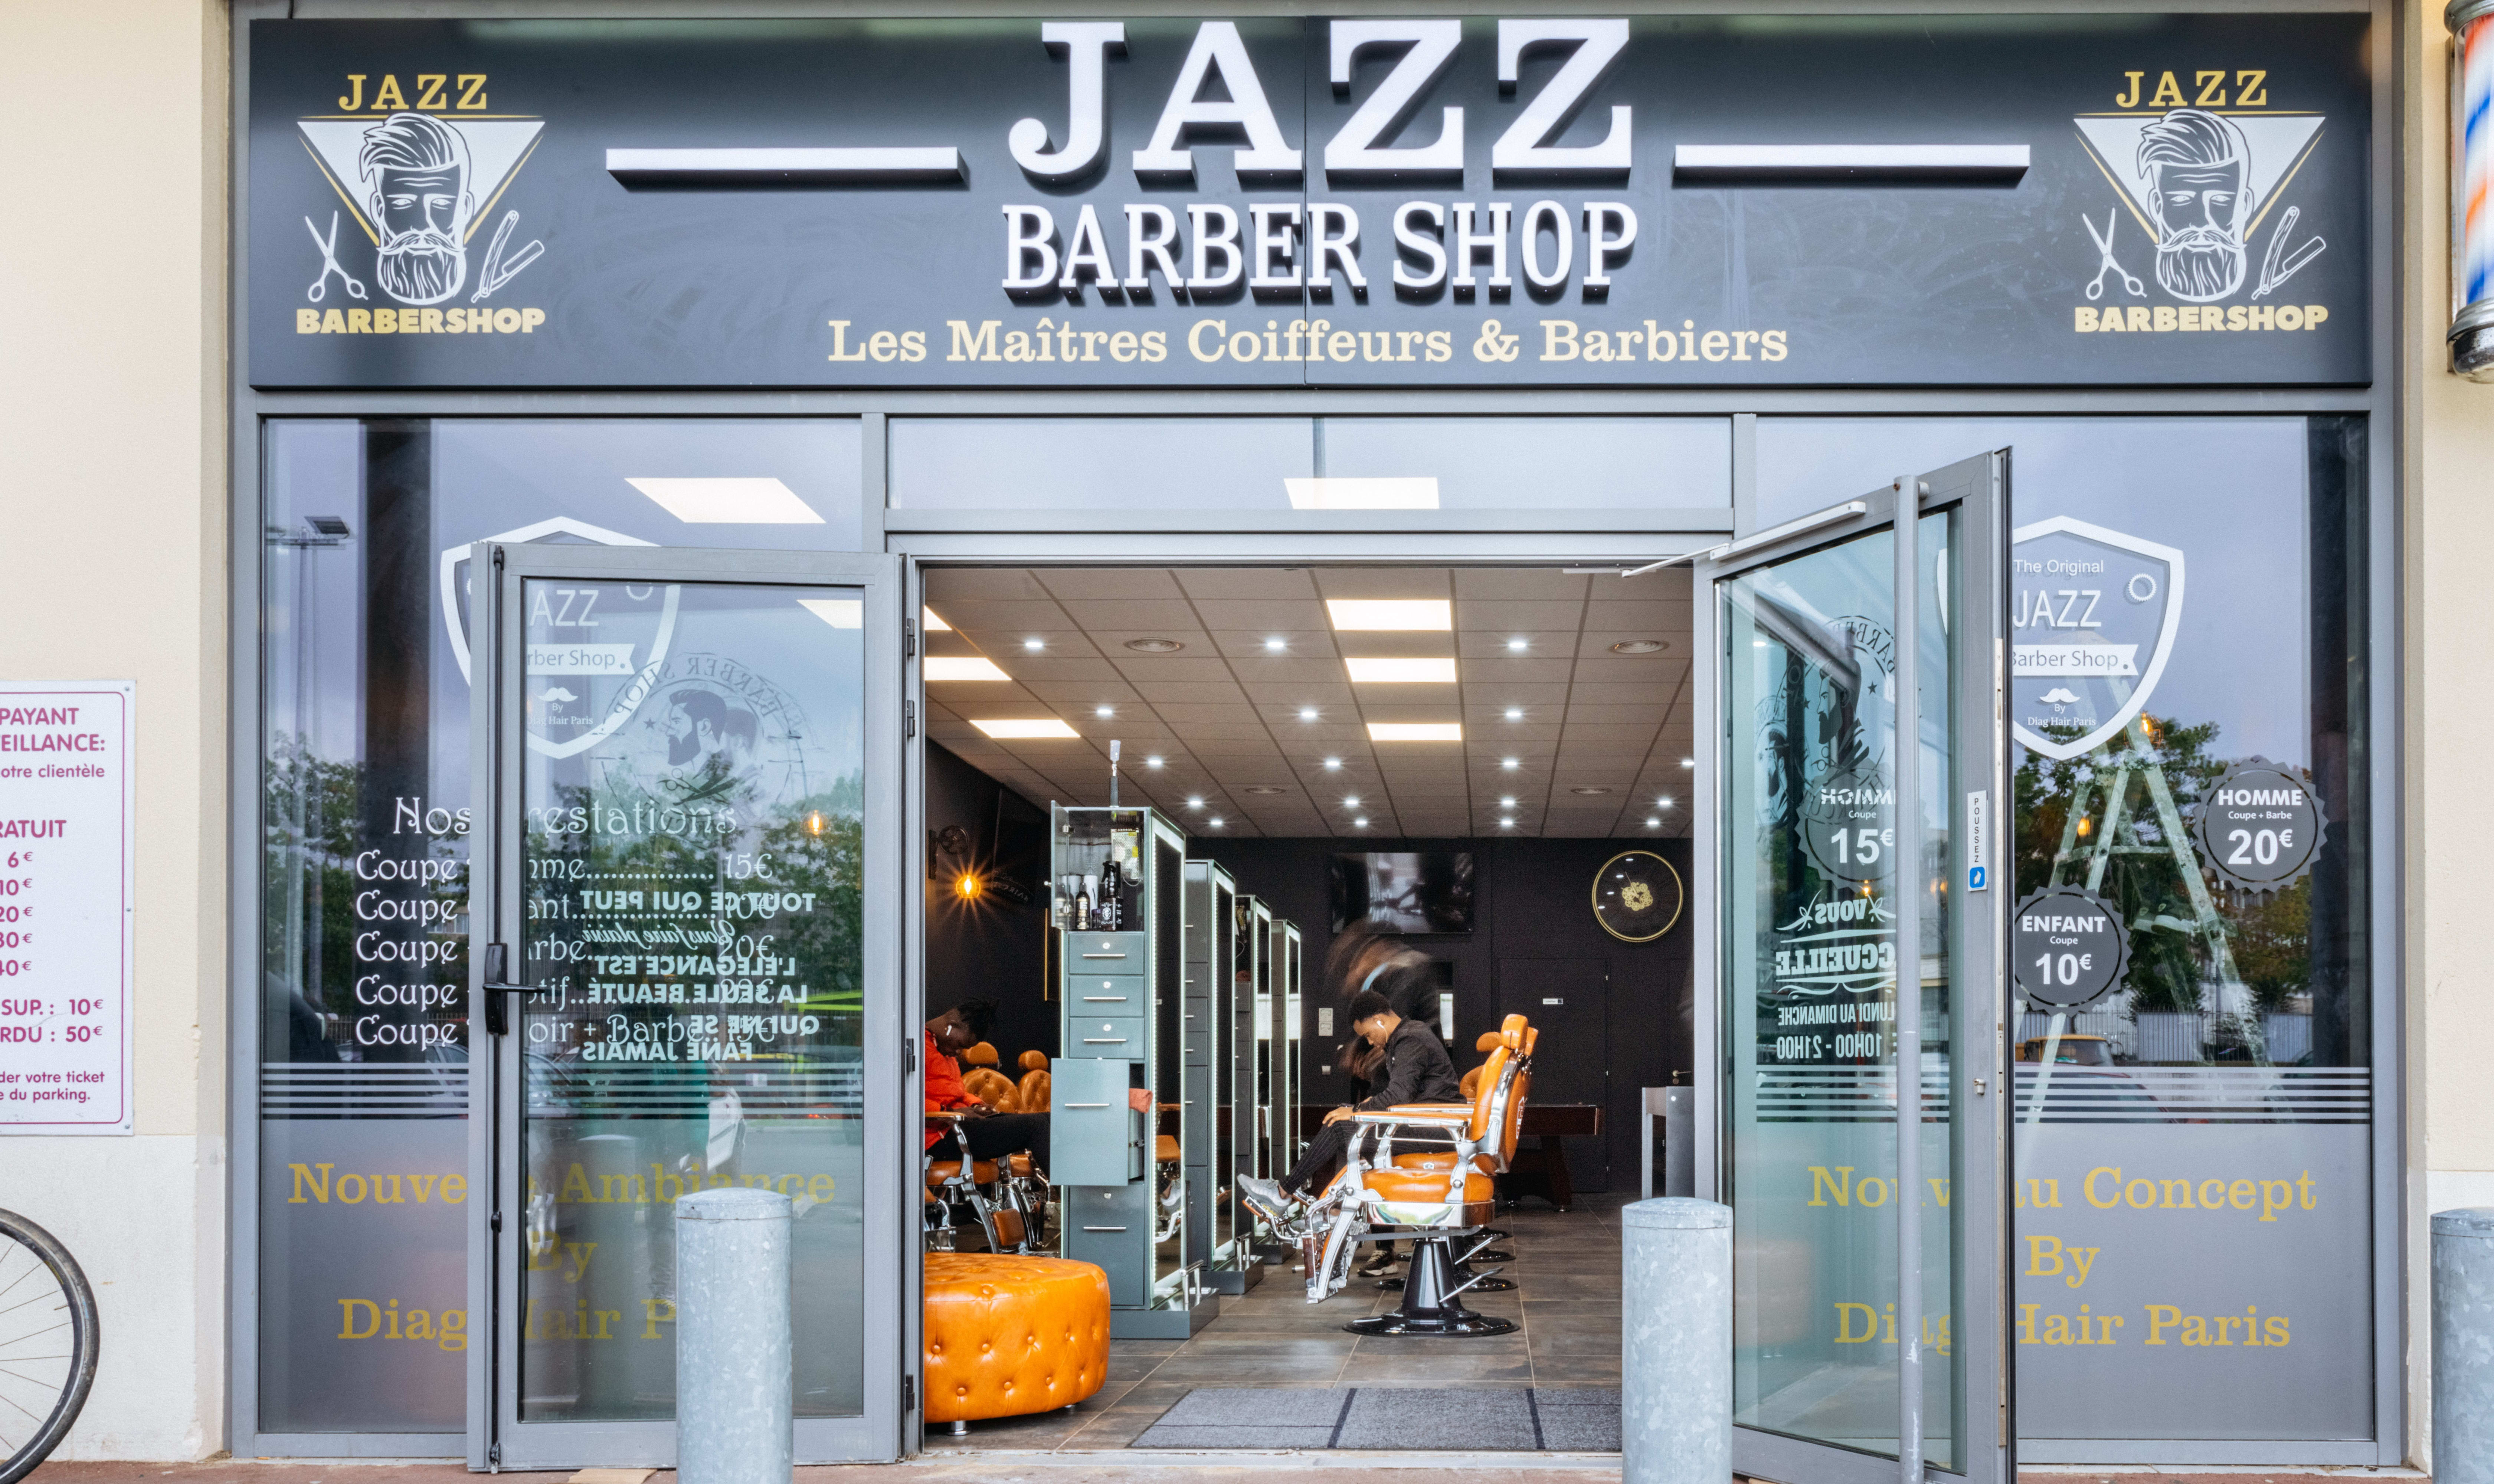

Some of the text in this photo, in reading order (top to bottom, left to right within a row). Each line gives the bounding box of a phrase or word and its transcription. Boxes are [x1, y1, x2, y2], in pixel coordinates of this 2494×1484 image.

[338, 74, 487, 111] JAZZ
[1008, 19, 1632, 176] JAZZ
[2116, 70, 2266, 108] JAZZ
[1002, 200, 1637, 289] BARBER SHOP
[297, 308, 546, 334] BARBERSHOP
[2075, 305, 2328, 332] BARBERSHOP
[828, 317, 1789, 364] Les Maîtres Coiffeurs & Barbiers
[2013, 559, 2104, 576] The Original
[530, 589, 599, 626] AZZ
[2013, 590, 2102, 627] JAZZ
[569, 649, 615, 670] Shop
[2071, 650, 2118, 670] Shop
[0, 707, 79, 725] PAYANT
[549, 716, 569, 725] Hair
[571, 716, 593, 725] Paris
[552, 703, 563, 713] By
[2054, 704, 2066, 714] By
[2027, 717, 2096, 727] Diag Hair Paris
[0, 733, 105, 751] EILLANCE:
[38, 763, 105, 778] clientèle
[1821, 789, 1896, 805] HOMM
[2218, 789, 2302, 806] HOMME
[393, 797, 737, 838] Nos restations
[1848, 810, 1877, 820] Coupe
[2228, 811, 2256, 820] Coupe
[2266, 811, 2292, 819] Barbe
[0, 820, 67, 838] ATUIT
[1831, 828, 1894, 864] 15€
[2228, 829, 2293, 865] 20€
[356, 849, 458, 887] Coupe
[725, 852, 773, 879] 15€
[356, 890, 458, 927] Coupe
[2022, 915, 2106, 933] ENFANT
[356, 931, 458, 968] Coupe
[2050, 936, 2078, 946] Coupe
[2036, 953, 2092, 985] 10€
[356, 974, 458, 1012] Coupe
[1, 999, 43, 1016] SUP.
[69, 999, 104, 1015] 10€
[65, 1026, 103, 1042] 50€
[356, 1014, 458, 1052] Coupe
[584, 1022, 596, 1036] +
[26, 1071, 61, 1083] votre
[66, 1071, 105, 1083] ticket
[10, 1088, 27, 1101] du
[33, 1088, 91, 1104] parking.
[2084, 1166, 2317, 1221] Concept
[527, 1231, 598, 1284] By
[2024, 1235, 2101, 1289] By
[337, 1298, 468, 1352] Diag
[2144, 1304, 2291, 1347] Paris
